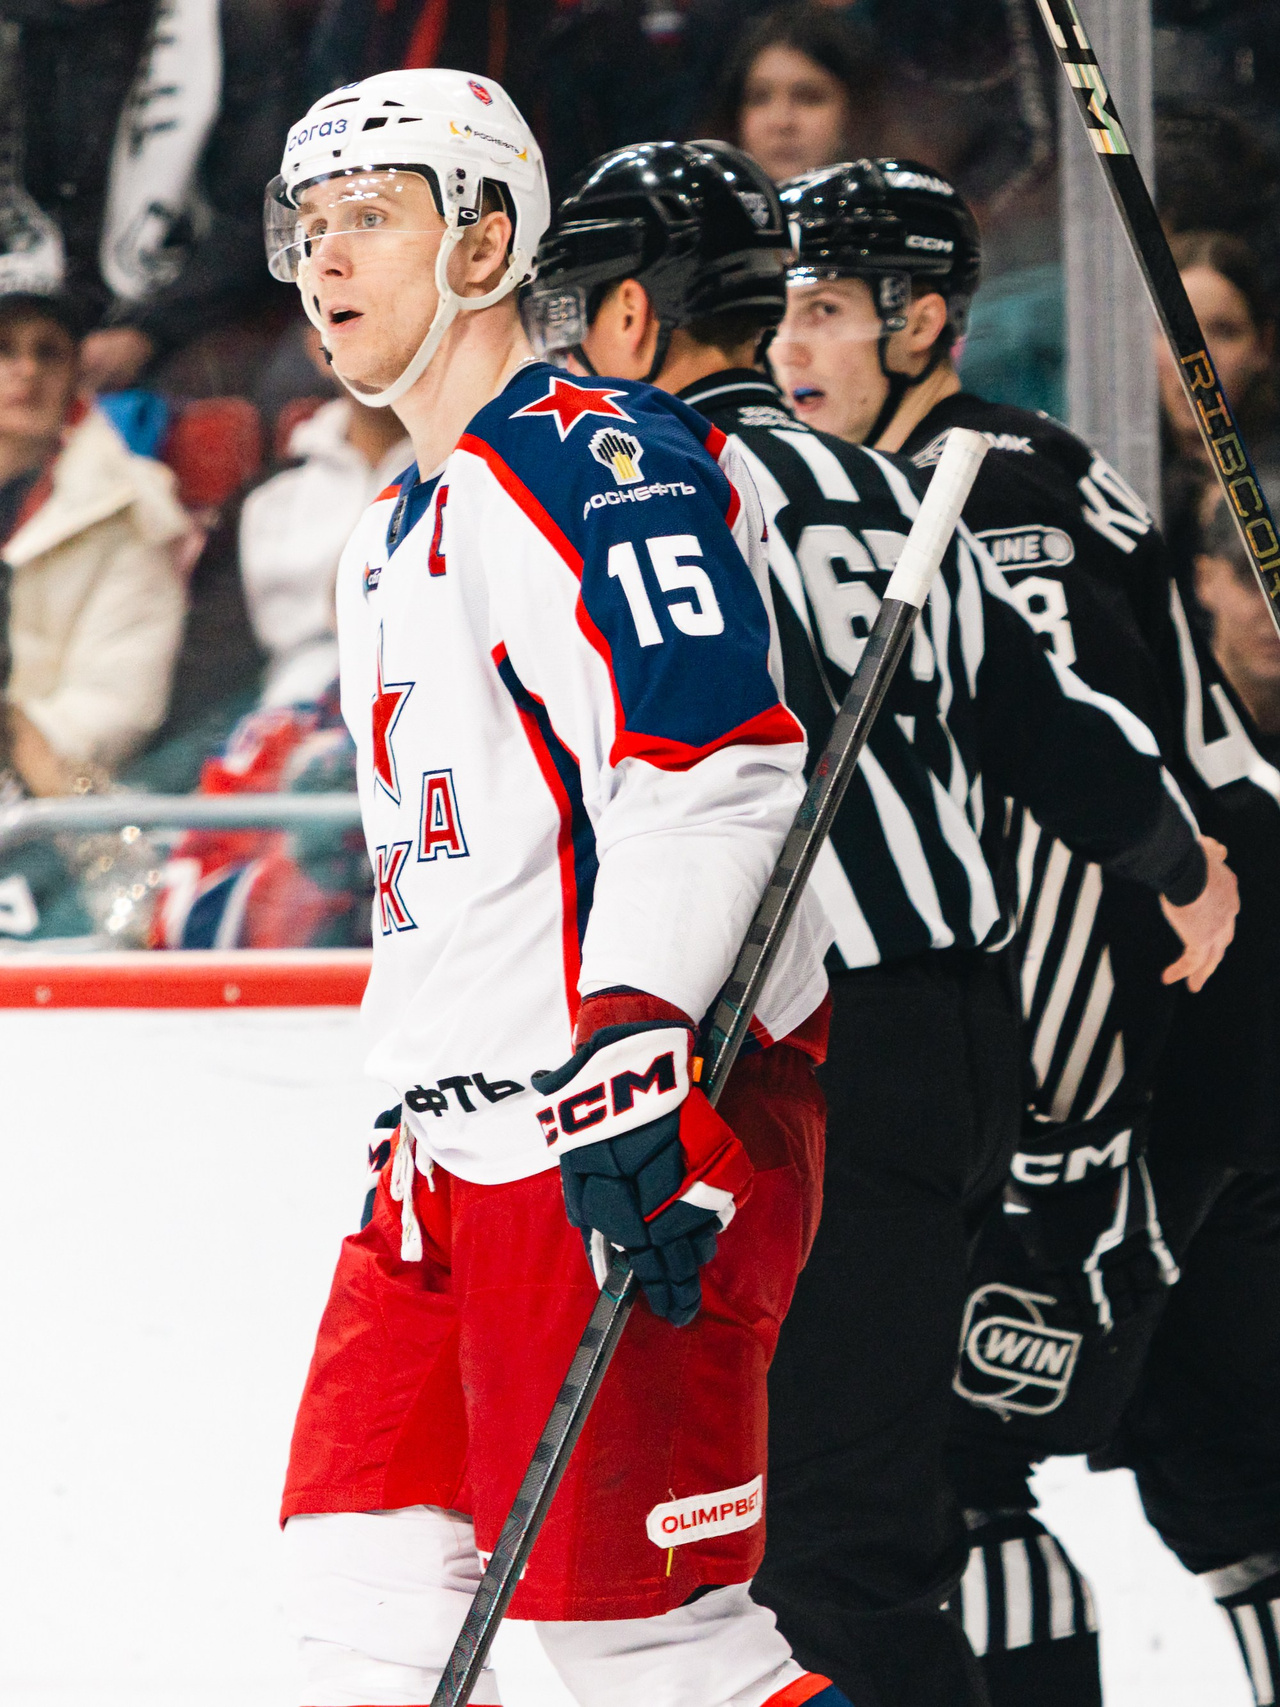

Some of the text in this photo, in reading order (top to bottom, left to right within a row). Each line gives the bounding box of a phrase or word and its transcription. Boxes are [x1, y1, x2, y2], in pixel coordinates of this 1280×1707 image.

[287, 118, 348, 153] согаз
[905, 234, 955, 254] CCM
[607, 533, 725, 649] 15
[984, 1327, 1071, 1376] WIN
[661, 1487, 760, 1535] OLIMPBET
